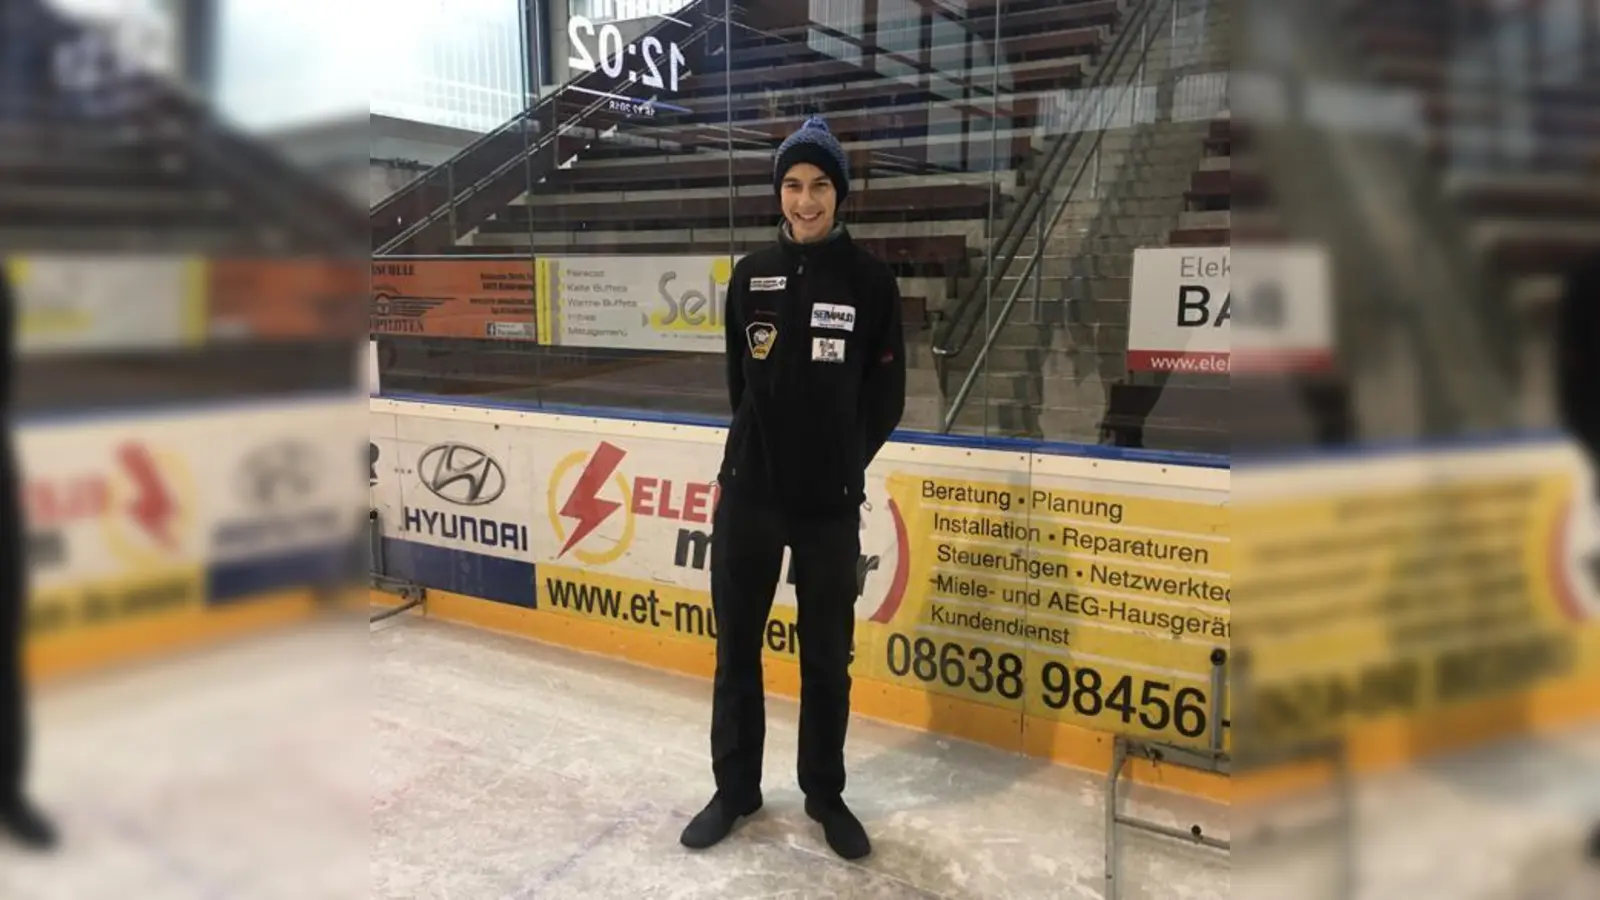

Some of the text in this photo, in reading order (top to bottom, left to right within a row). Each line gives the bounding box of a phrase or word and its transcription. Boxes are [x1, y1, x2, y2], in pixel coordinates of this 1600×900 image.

[630, 475, 721, 525] ELE
[922, 480, 1124, 523] Beratung Planung
[404, 506, 528, 551] HYUNDAI
[934, 513, 1208, 564] Installation Reparaturen
[937, 544, 1068, 579] Steuerungen
[1002, 589, 1041, 606] und
[931, 605, 1069, 645] Kundendienst
[887, 633, 1024, 700] 08638
[1042, 661, 1208, 738] 98456
